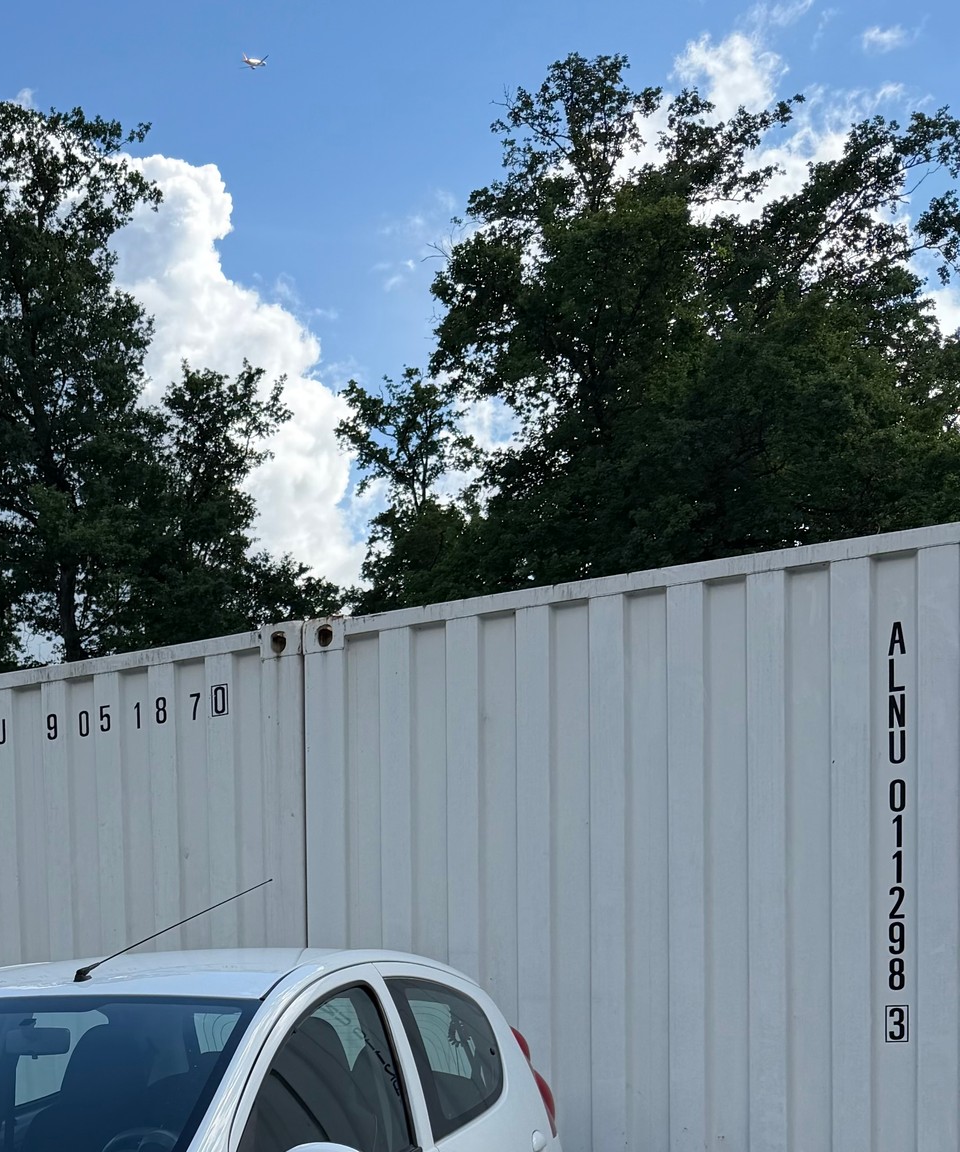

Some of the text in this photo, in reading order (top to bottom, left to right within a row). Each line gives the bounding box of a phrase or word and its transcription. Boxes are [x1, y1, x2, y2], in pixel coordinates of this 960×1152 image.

[887, 621, 907, 1041] ALNU 011298 3
